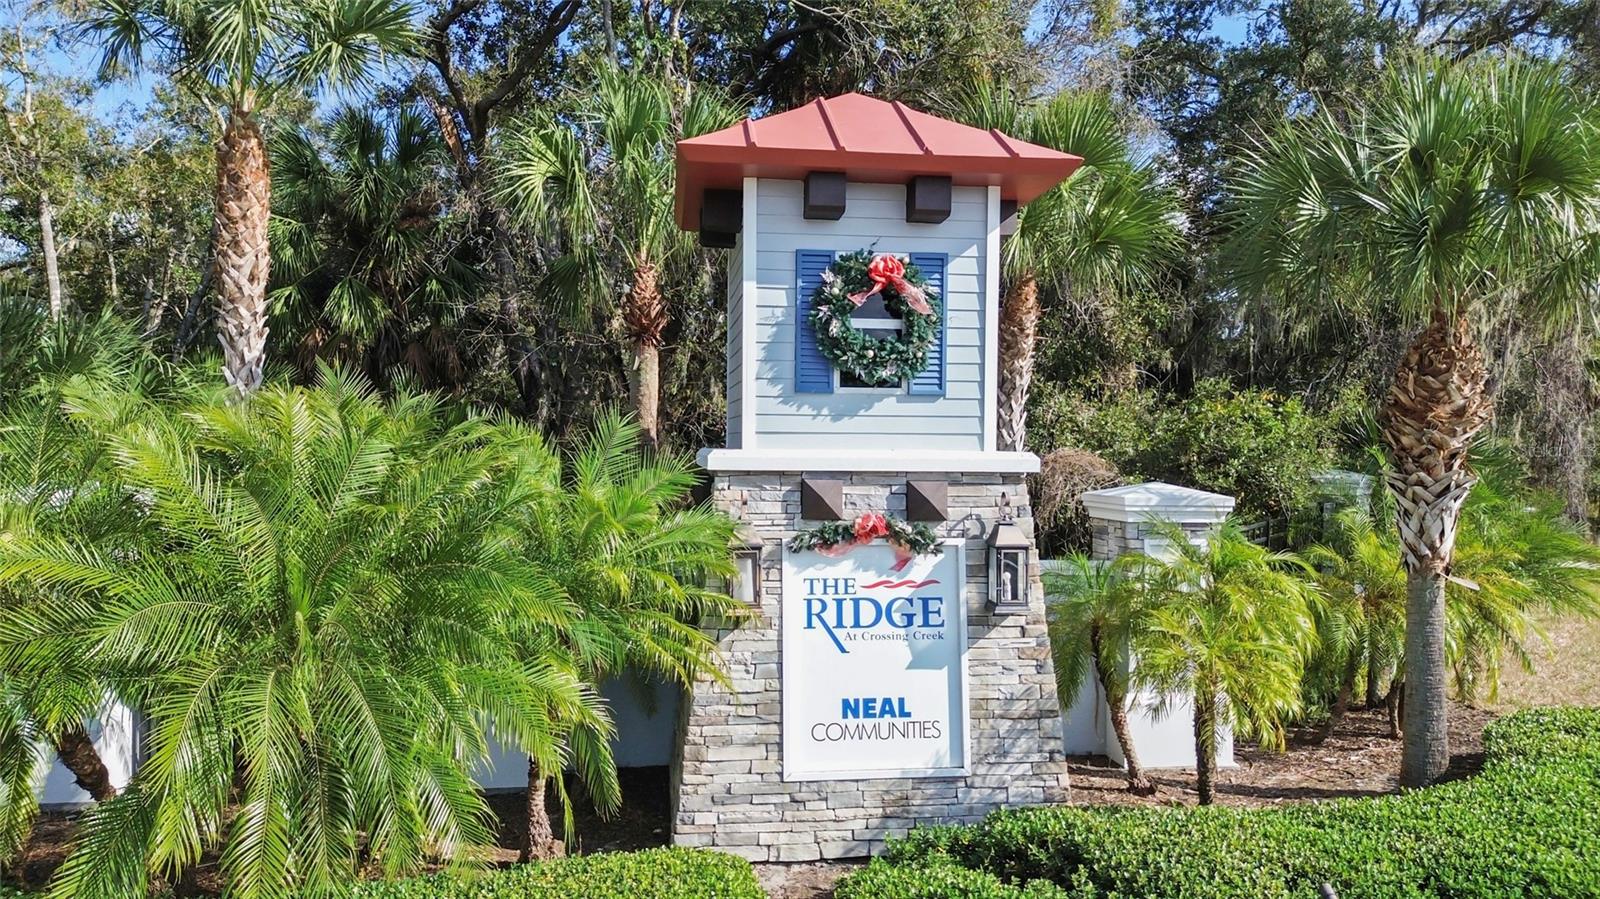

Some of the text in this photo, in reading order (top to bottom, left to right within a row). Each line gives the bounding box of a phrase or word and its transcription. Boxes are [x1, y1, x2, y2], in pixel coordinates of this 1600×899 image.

[803, 577, 857, 595] THE
[803, 596, 945, 653] RIDGE
[844, 630, 944, 642] At Crossing Creek
[841, 697, 911, 719] NEAL
[811, 720, 941, 742] COMMUNITIES
